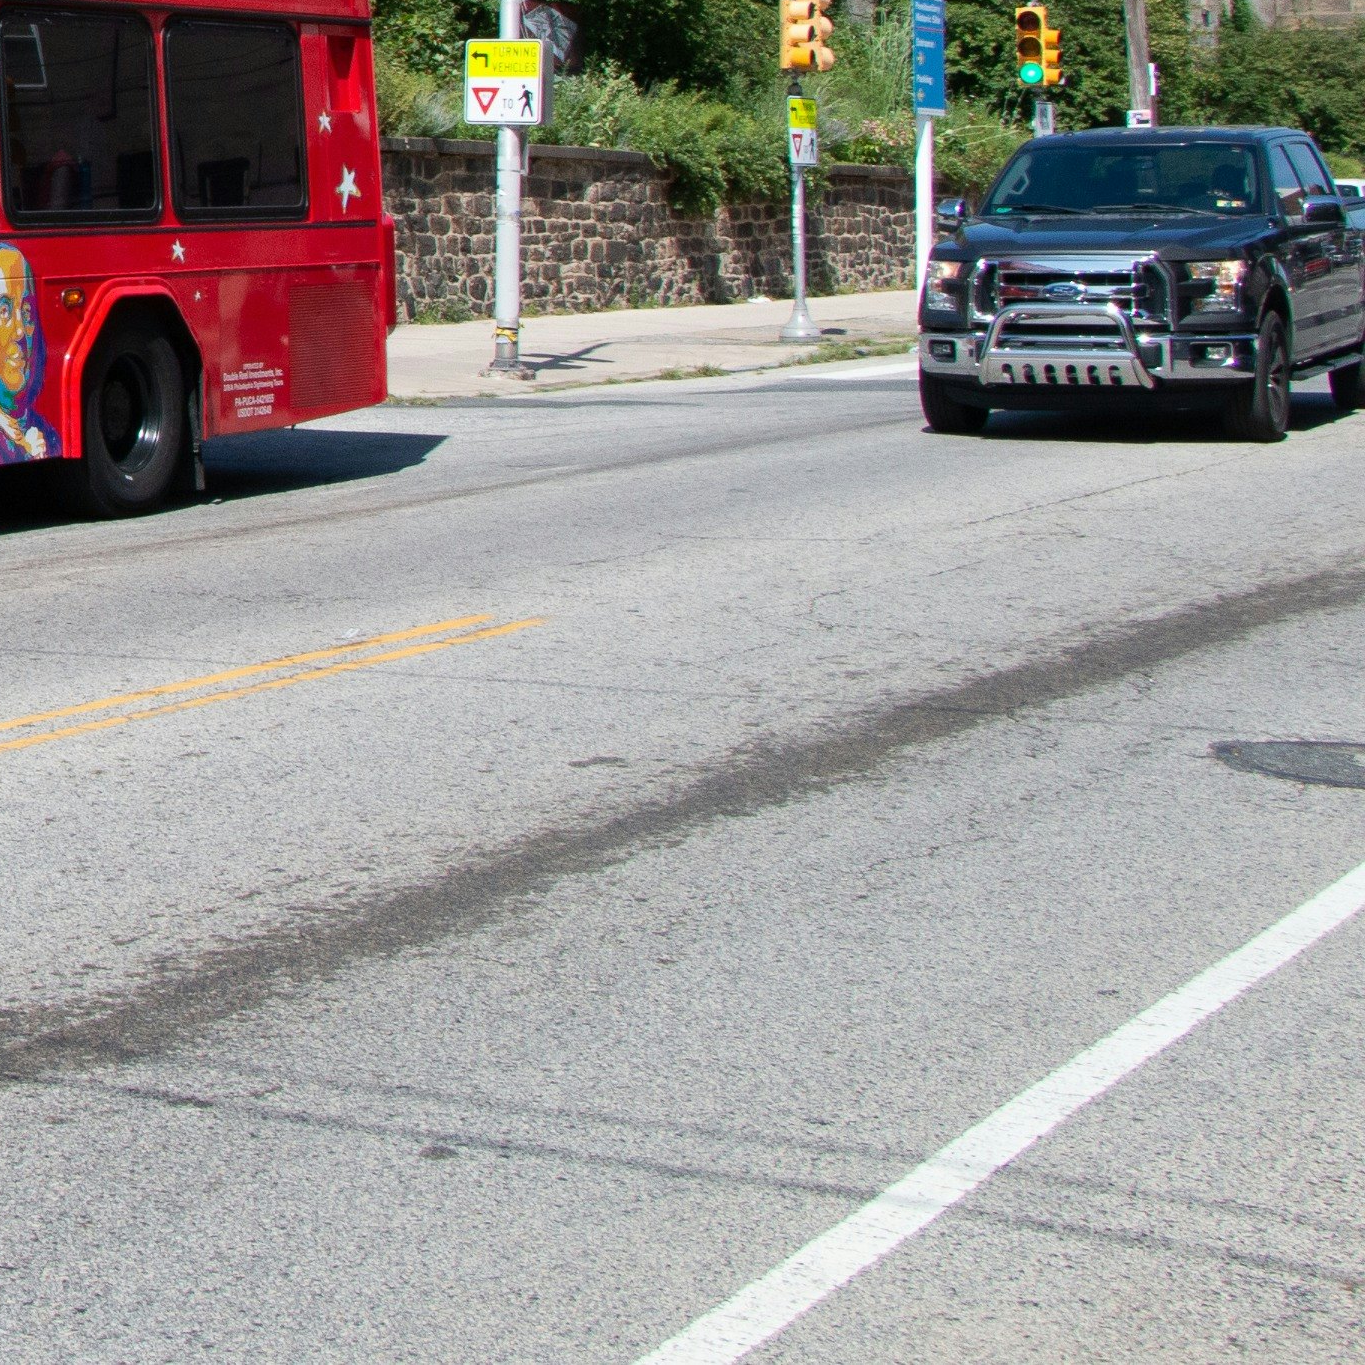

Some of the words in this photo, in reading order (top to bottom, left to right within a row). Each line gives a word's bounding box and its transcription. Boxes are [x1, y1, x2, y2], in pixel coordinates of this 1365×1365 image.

[493, 46, 537, 57] TURNING
[492, 62, 537, 73] VEHICLES
[502, 98, 514, 109] TO
